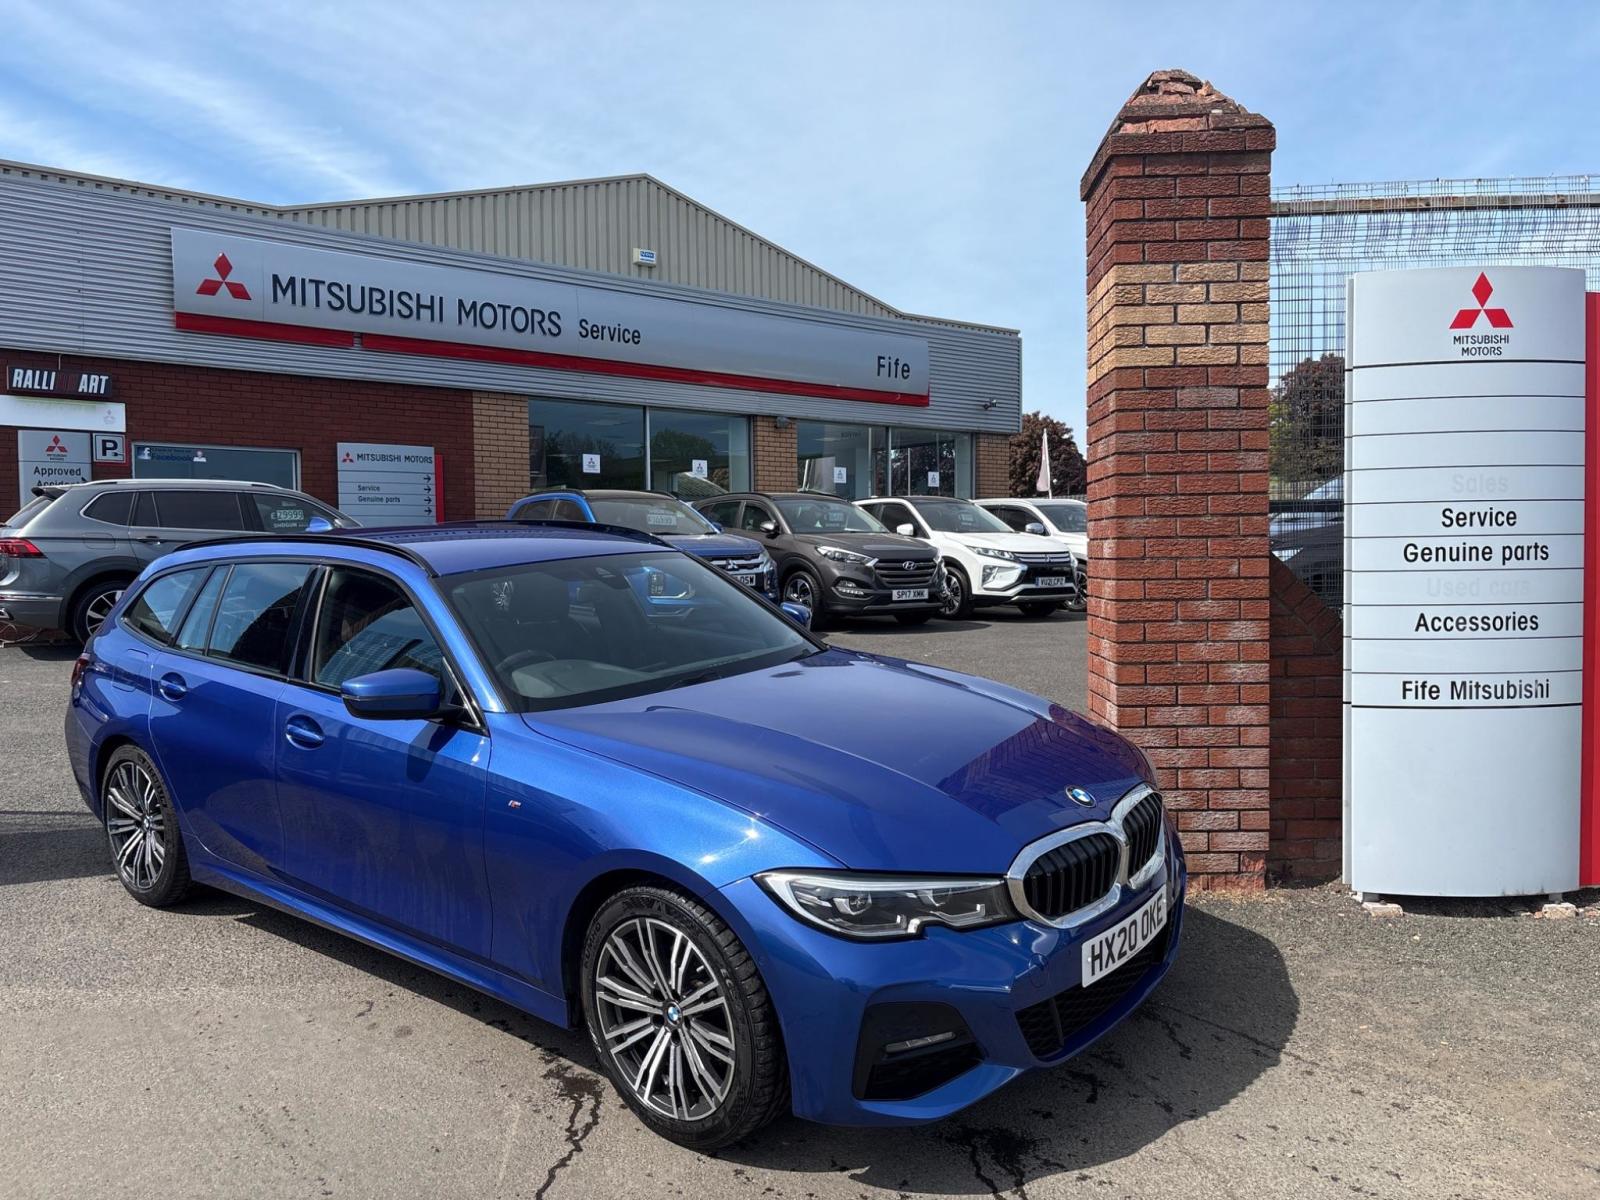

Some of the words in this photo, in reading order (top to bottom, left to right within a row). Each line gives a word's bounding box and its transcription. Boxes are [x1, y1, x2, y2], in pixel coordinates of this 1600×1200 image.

[272, 273, 443, 323] MITSUBISHI
[457, 298, 562, 337] MOTORS
[578, 318, 641, 345] Service
[876, 355, 911, 380] Fife
[1453, 334, 1510, 345] MITSUBISHI
[1461, 346, 1502, 356] MOTORS
[12, 368, 56, 391] RALLI
[78, 373, 109, 394] ART
[101, 439, 118, 457] P
[356, 453, 402, 463] MITSUBISHI
[404, 455, 433, 464] MOTORS
[33, 466, 82, 477] Approved
[358, 484, 380, 492] Service
[1452, 473, 1510, 494] Sales
[358, 495, 384, 503] Genuine
[385, 496, 401, 504] parts
[1441, 507, 1517, 528] Service
[1403, 542, 1493, 563] Genuine
[1501, 542, 1549, 566] parts
[896, 590, 911, 599] SP17
[1414, 611, 1539, 633] Accessories
[1401, 680, 1440, 700] Fife
[1450, 678, 1550, 700] Mitsubishi
[1091, 919, 1137, 976] HX20
[1141, 893, 1163, 941] OKE
